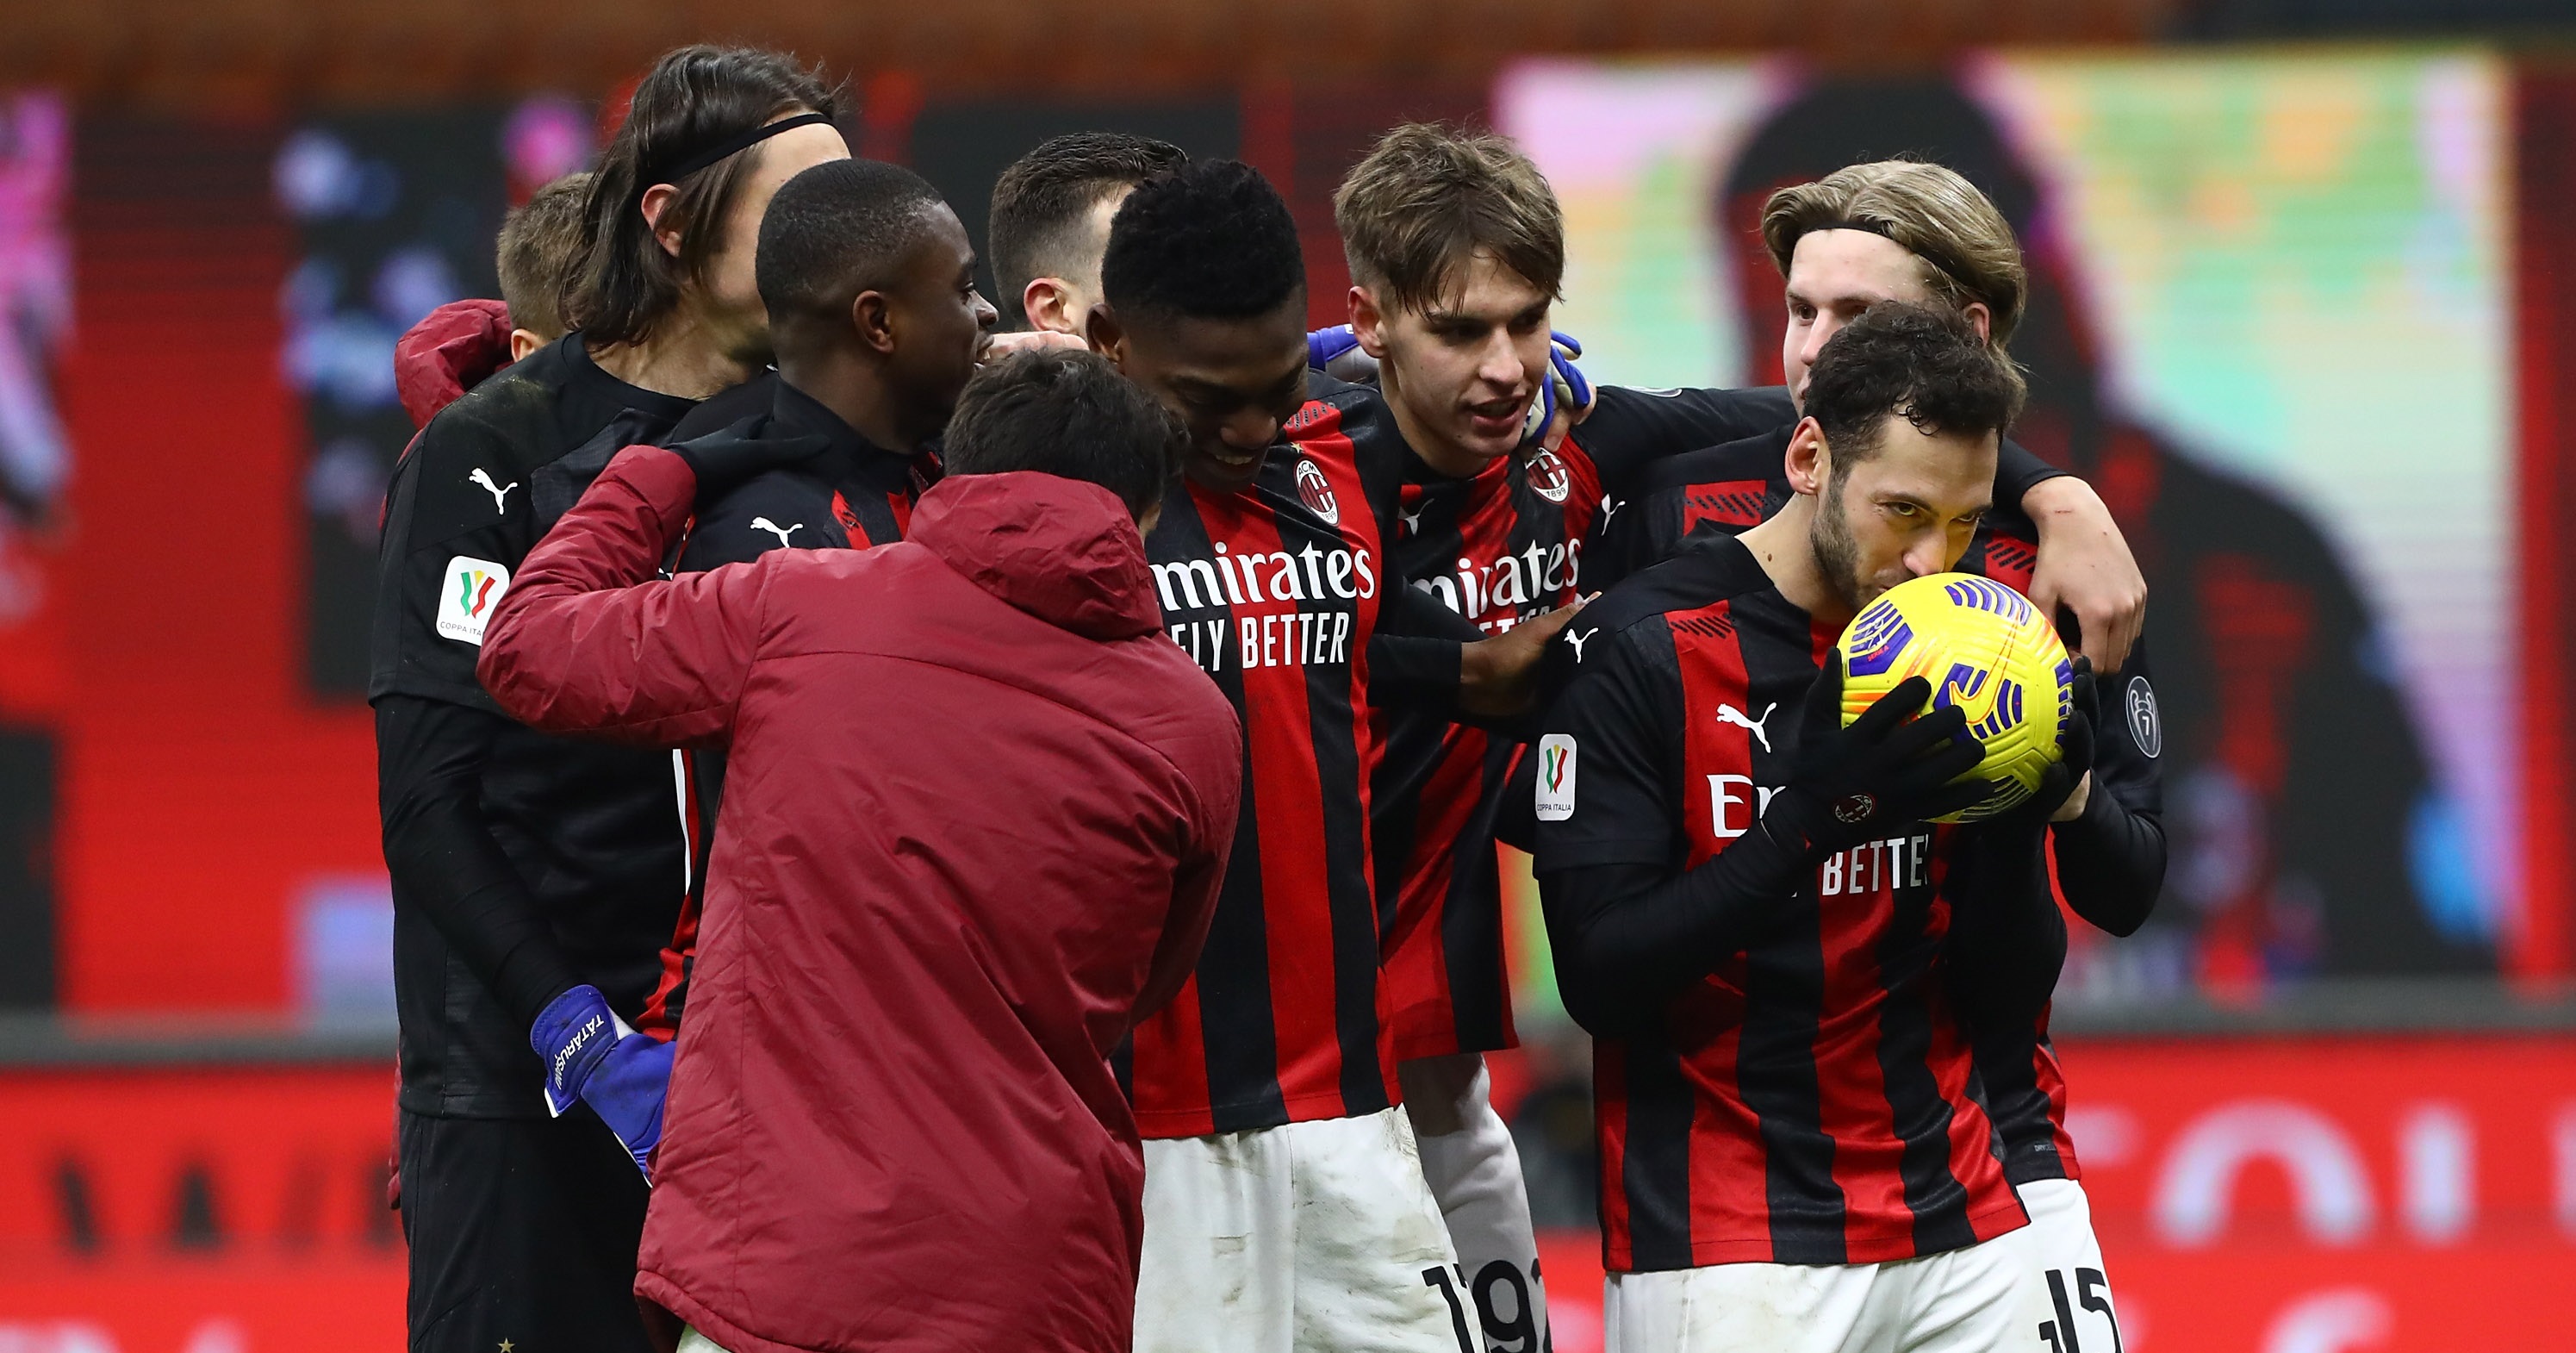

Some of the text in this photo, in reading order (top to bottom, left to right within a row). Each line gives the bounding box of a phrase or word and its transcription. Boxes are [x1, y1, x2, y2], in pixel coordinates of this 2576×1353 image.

[1298, 462, 1317, 478] ACM
[1546, 487, 1566, 497] 1899
[1148, 539, 1376, 612] mirates
[440, 621, 482, 637] COPPA ITA
[1241, 611, 1350, 670] BETTER
[2142, 715, 2150, 736] 7
[1553, 803, 1571, 812] ITALIA
[1822, 833, 1929, 895] BETTE
